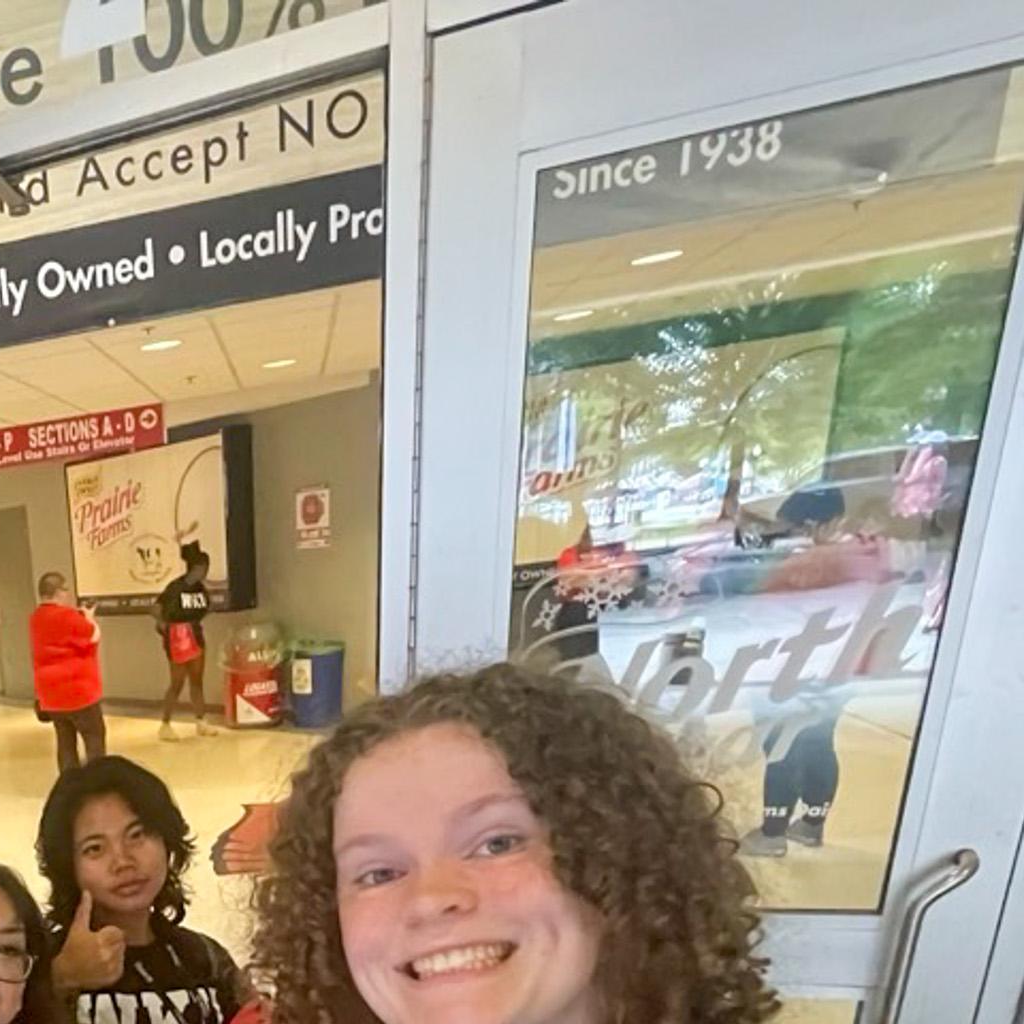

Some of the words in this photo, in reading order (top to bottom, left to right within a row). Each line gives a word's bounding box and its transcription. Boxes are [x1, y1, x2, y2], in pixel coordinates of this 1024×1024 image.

[76, 121, 249, 198] Accept
[278, 89, 370, 152] NO
[680, 121, 783, 177] 1938
[36, 239, 155, 298] Owned
[199, 213, 317, 270] Locally
[4, 431, 13, 452] P
[27, 417, 99, 449] SECTIONS
[102, 415, 114, 437] A
[123, 411, 136, 433] D
[75, 479, 143, 533] Prairie
[87, 515, 133, 551] Farms
